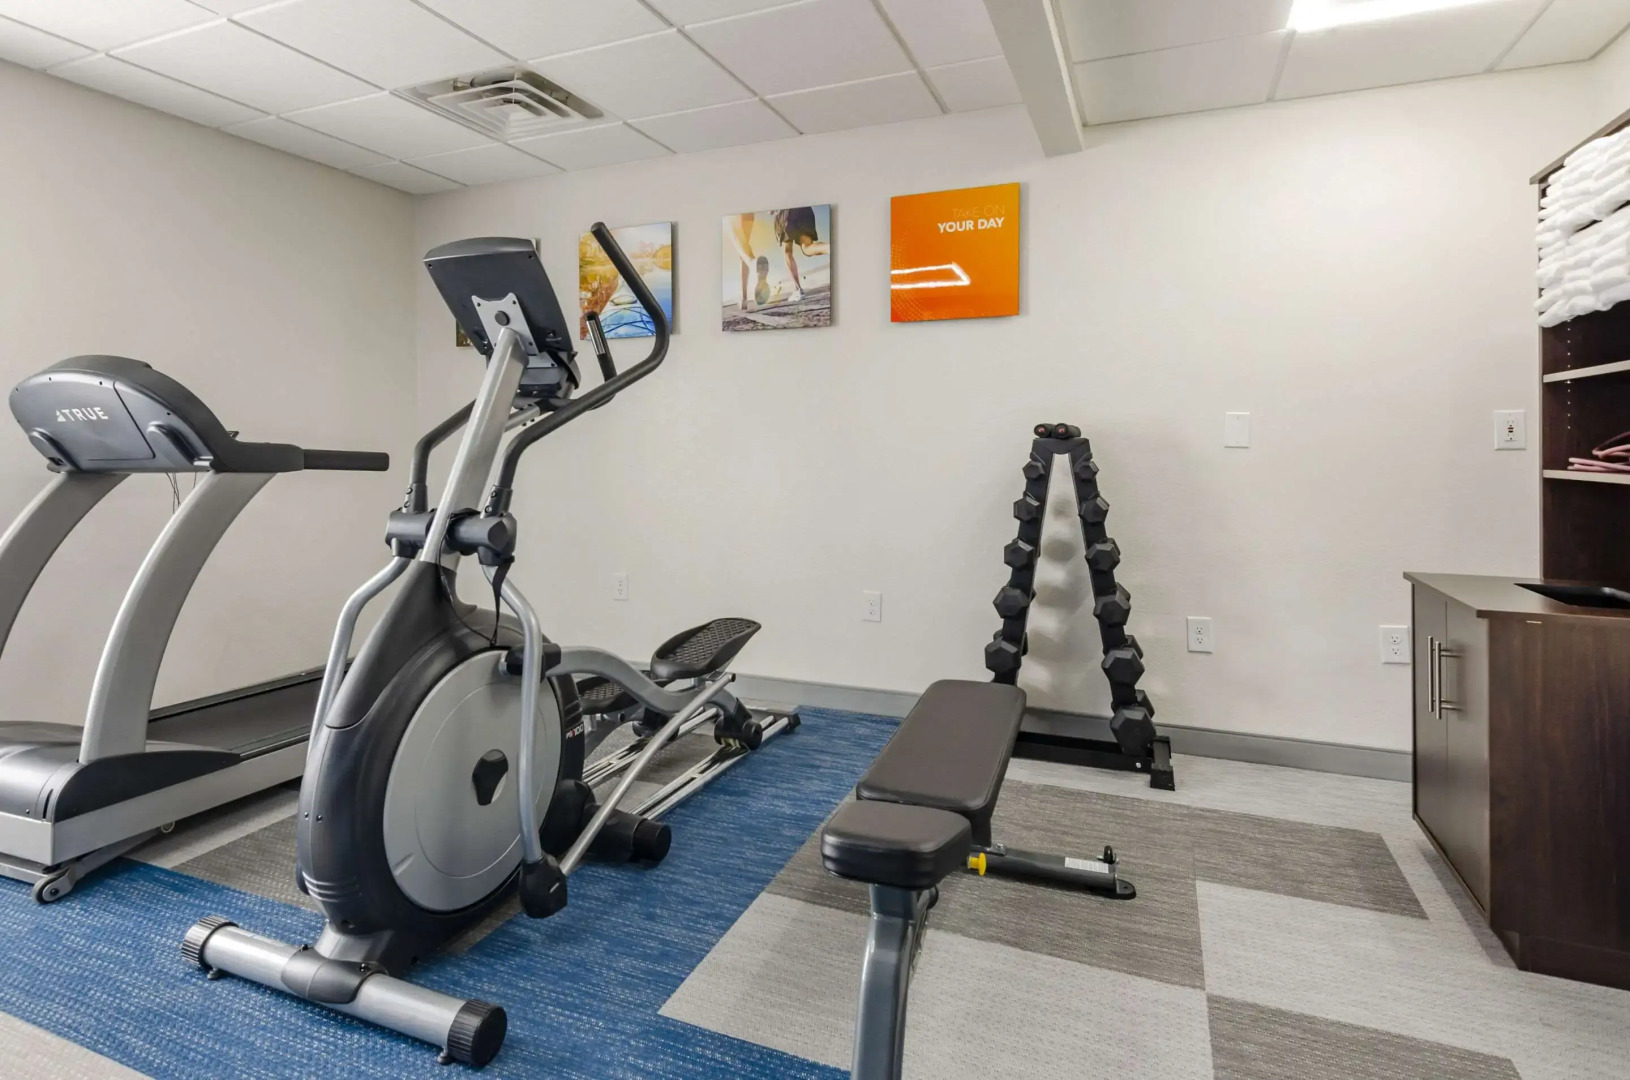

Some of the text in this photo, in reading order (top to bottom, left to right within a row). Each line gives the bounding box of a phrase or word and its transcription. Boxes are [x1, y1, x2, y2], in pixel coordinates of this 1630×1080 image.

[952, 205, 1005, 218] TAKE ON
[937, 217, 1005, 233] YOUR DAY
[61, 407, 109, 421] TRUE
